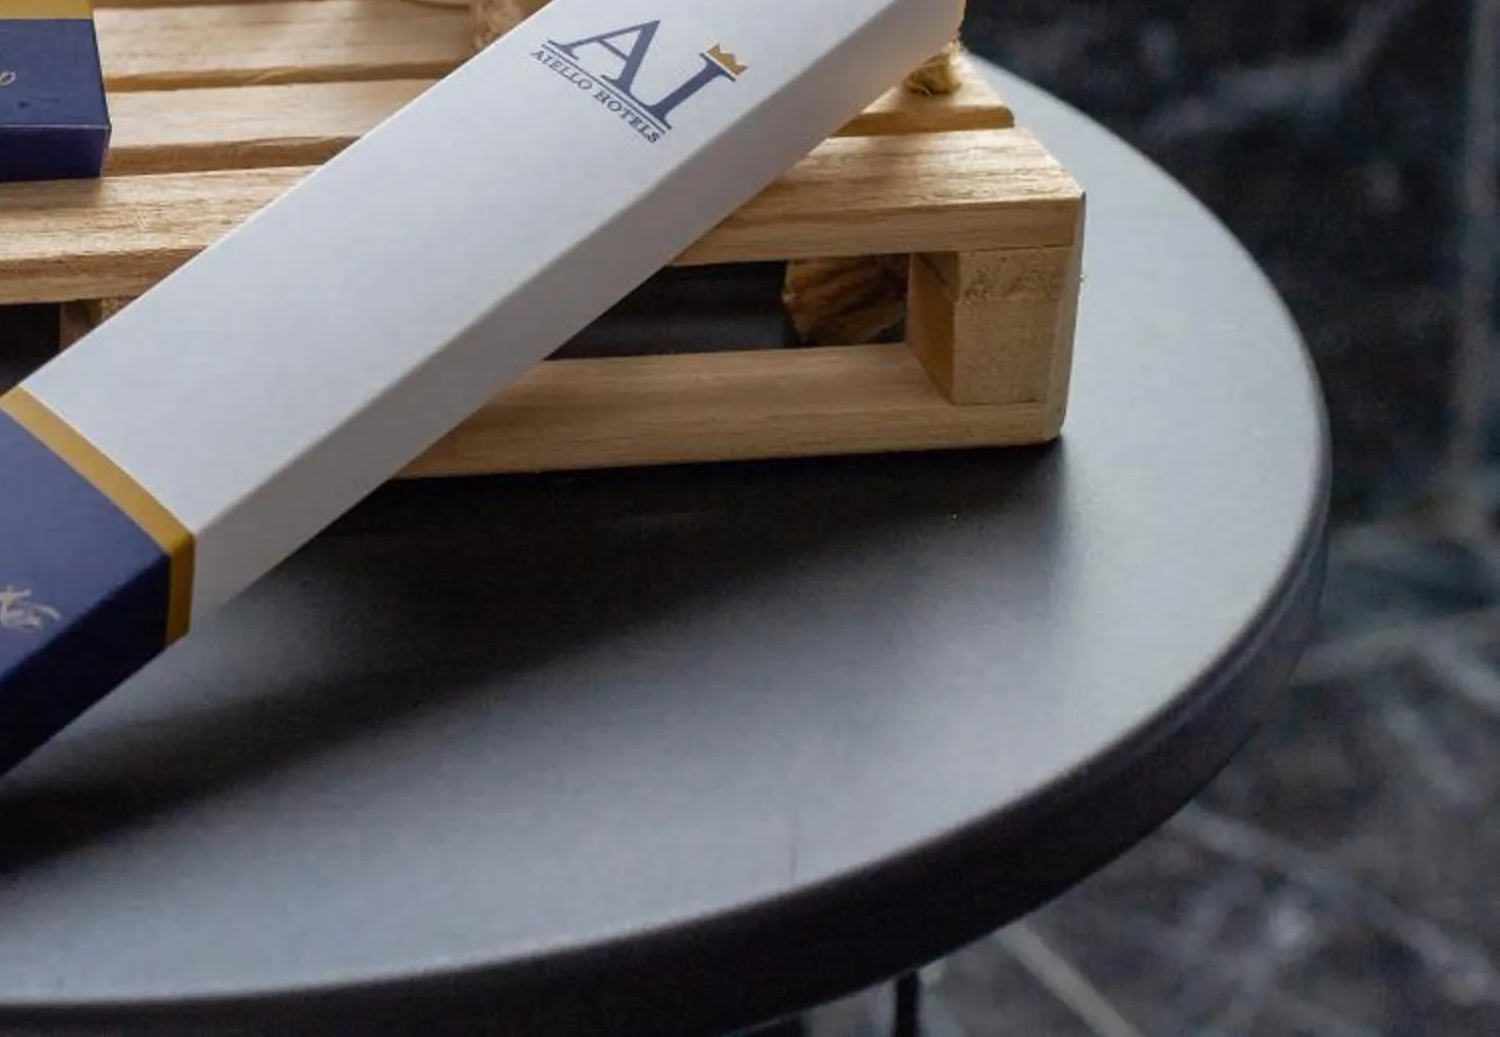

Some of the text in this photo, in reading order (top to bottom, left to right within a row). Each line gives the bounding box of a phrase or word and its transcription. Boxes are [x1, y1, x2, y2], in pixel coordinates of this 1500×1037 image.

[530, 48, 662, 144] AIELLO HOTELS
[547, 20, 736, 130] AI
